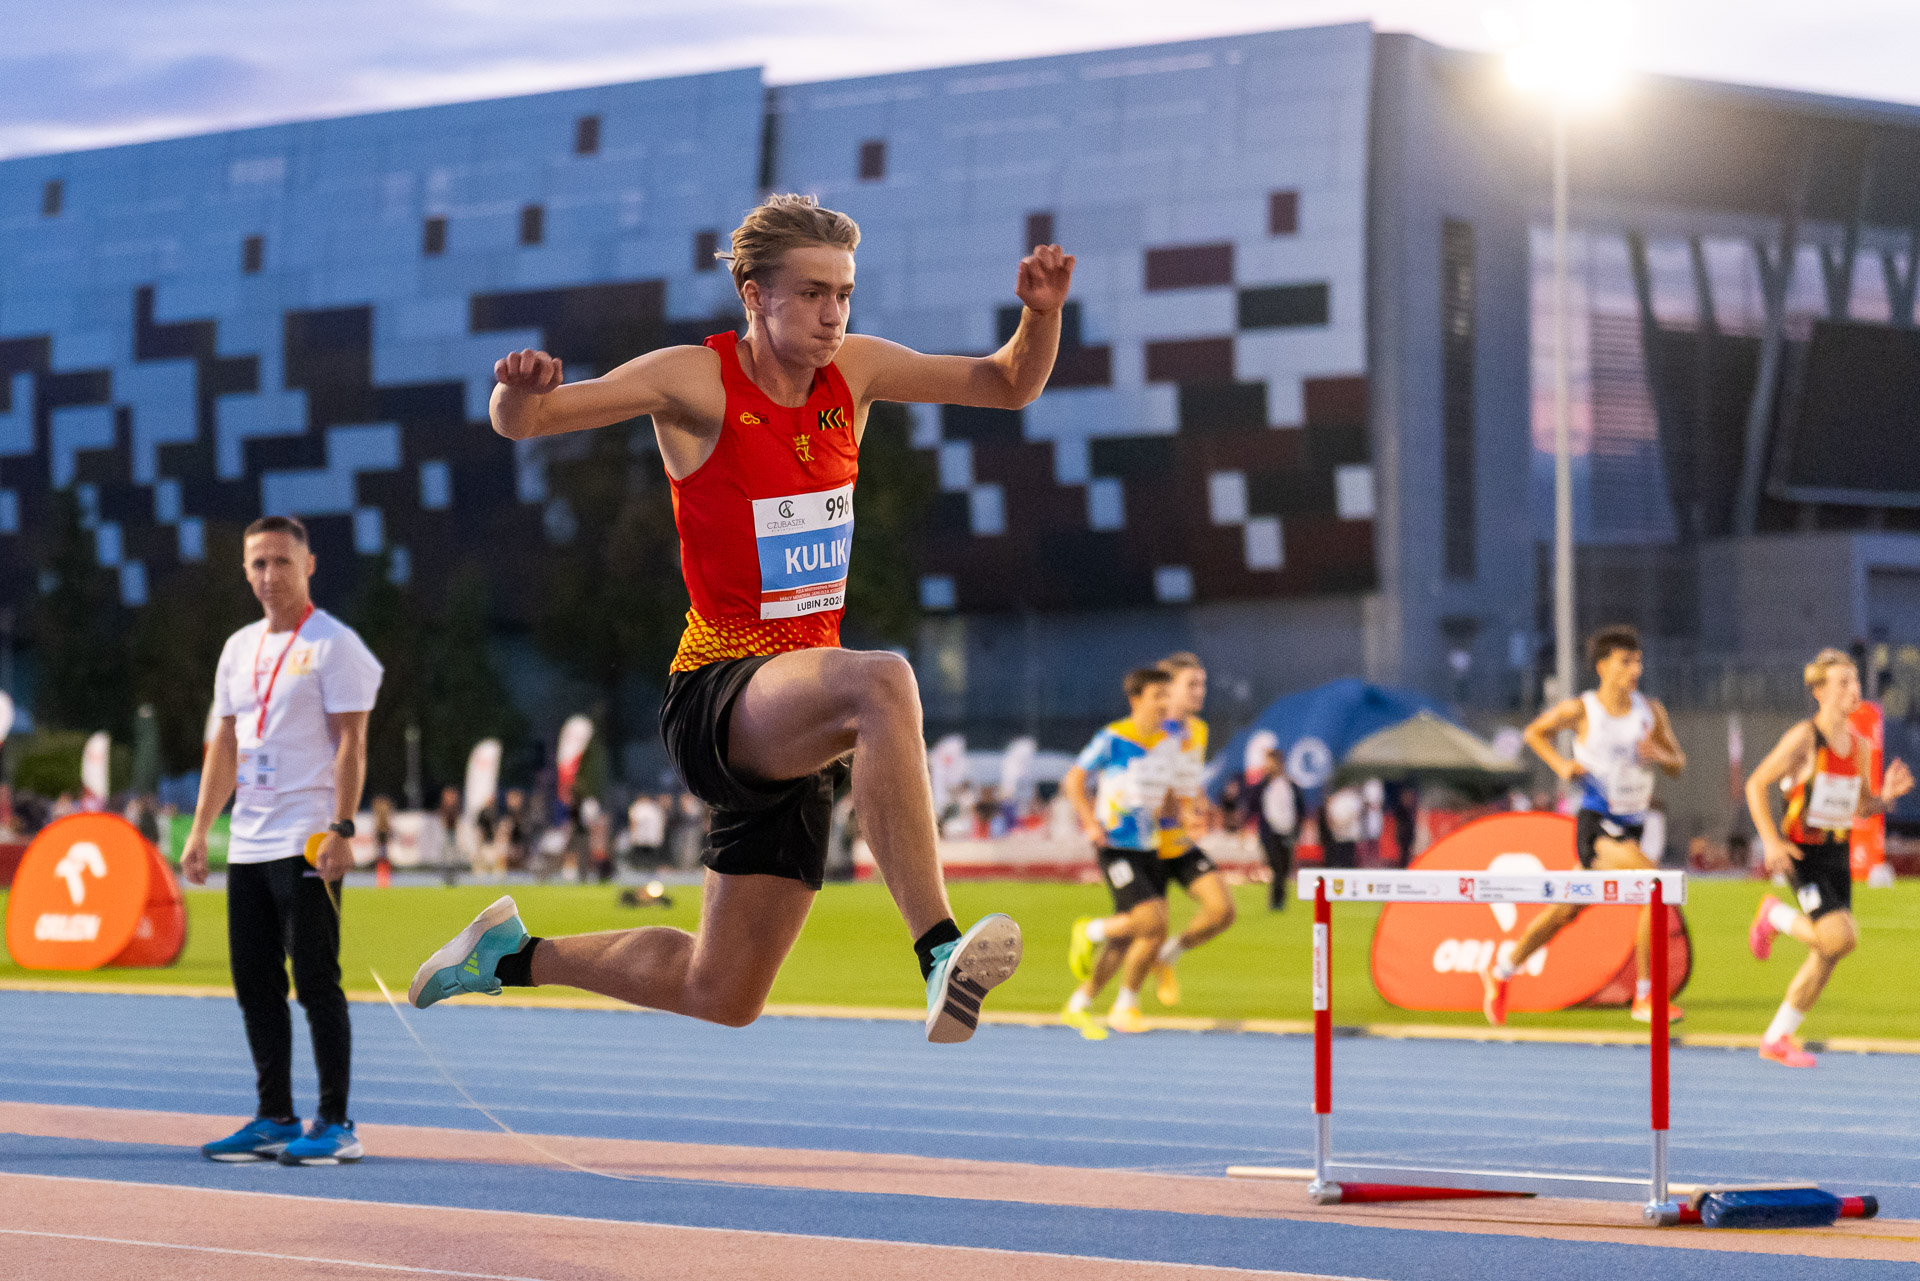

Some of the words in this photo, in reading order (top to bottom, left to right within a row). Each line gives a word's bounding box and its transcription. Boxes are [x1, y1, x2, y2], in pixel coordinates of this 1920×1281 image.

[825, 492, 849, 521] 996
[766, 518, 806, 530] CZUBASZEK
[784, 537, 847, 575] KULIK
[797, 598, 821, 612] LUBIN
